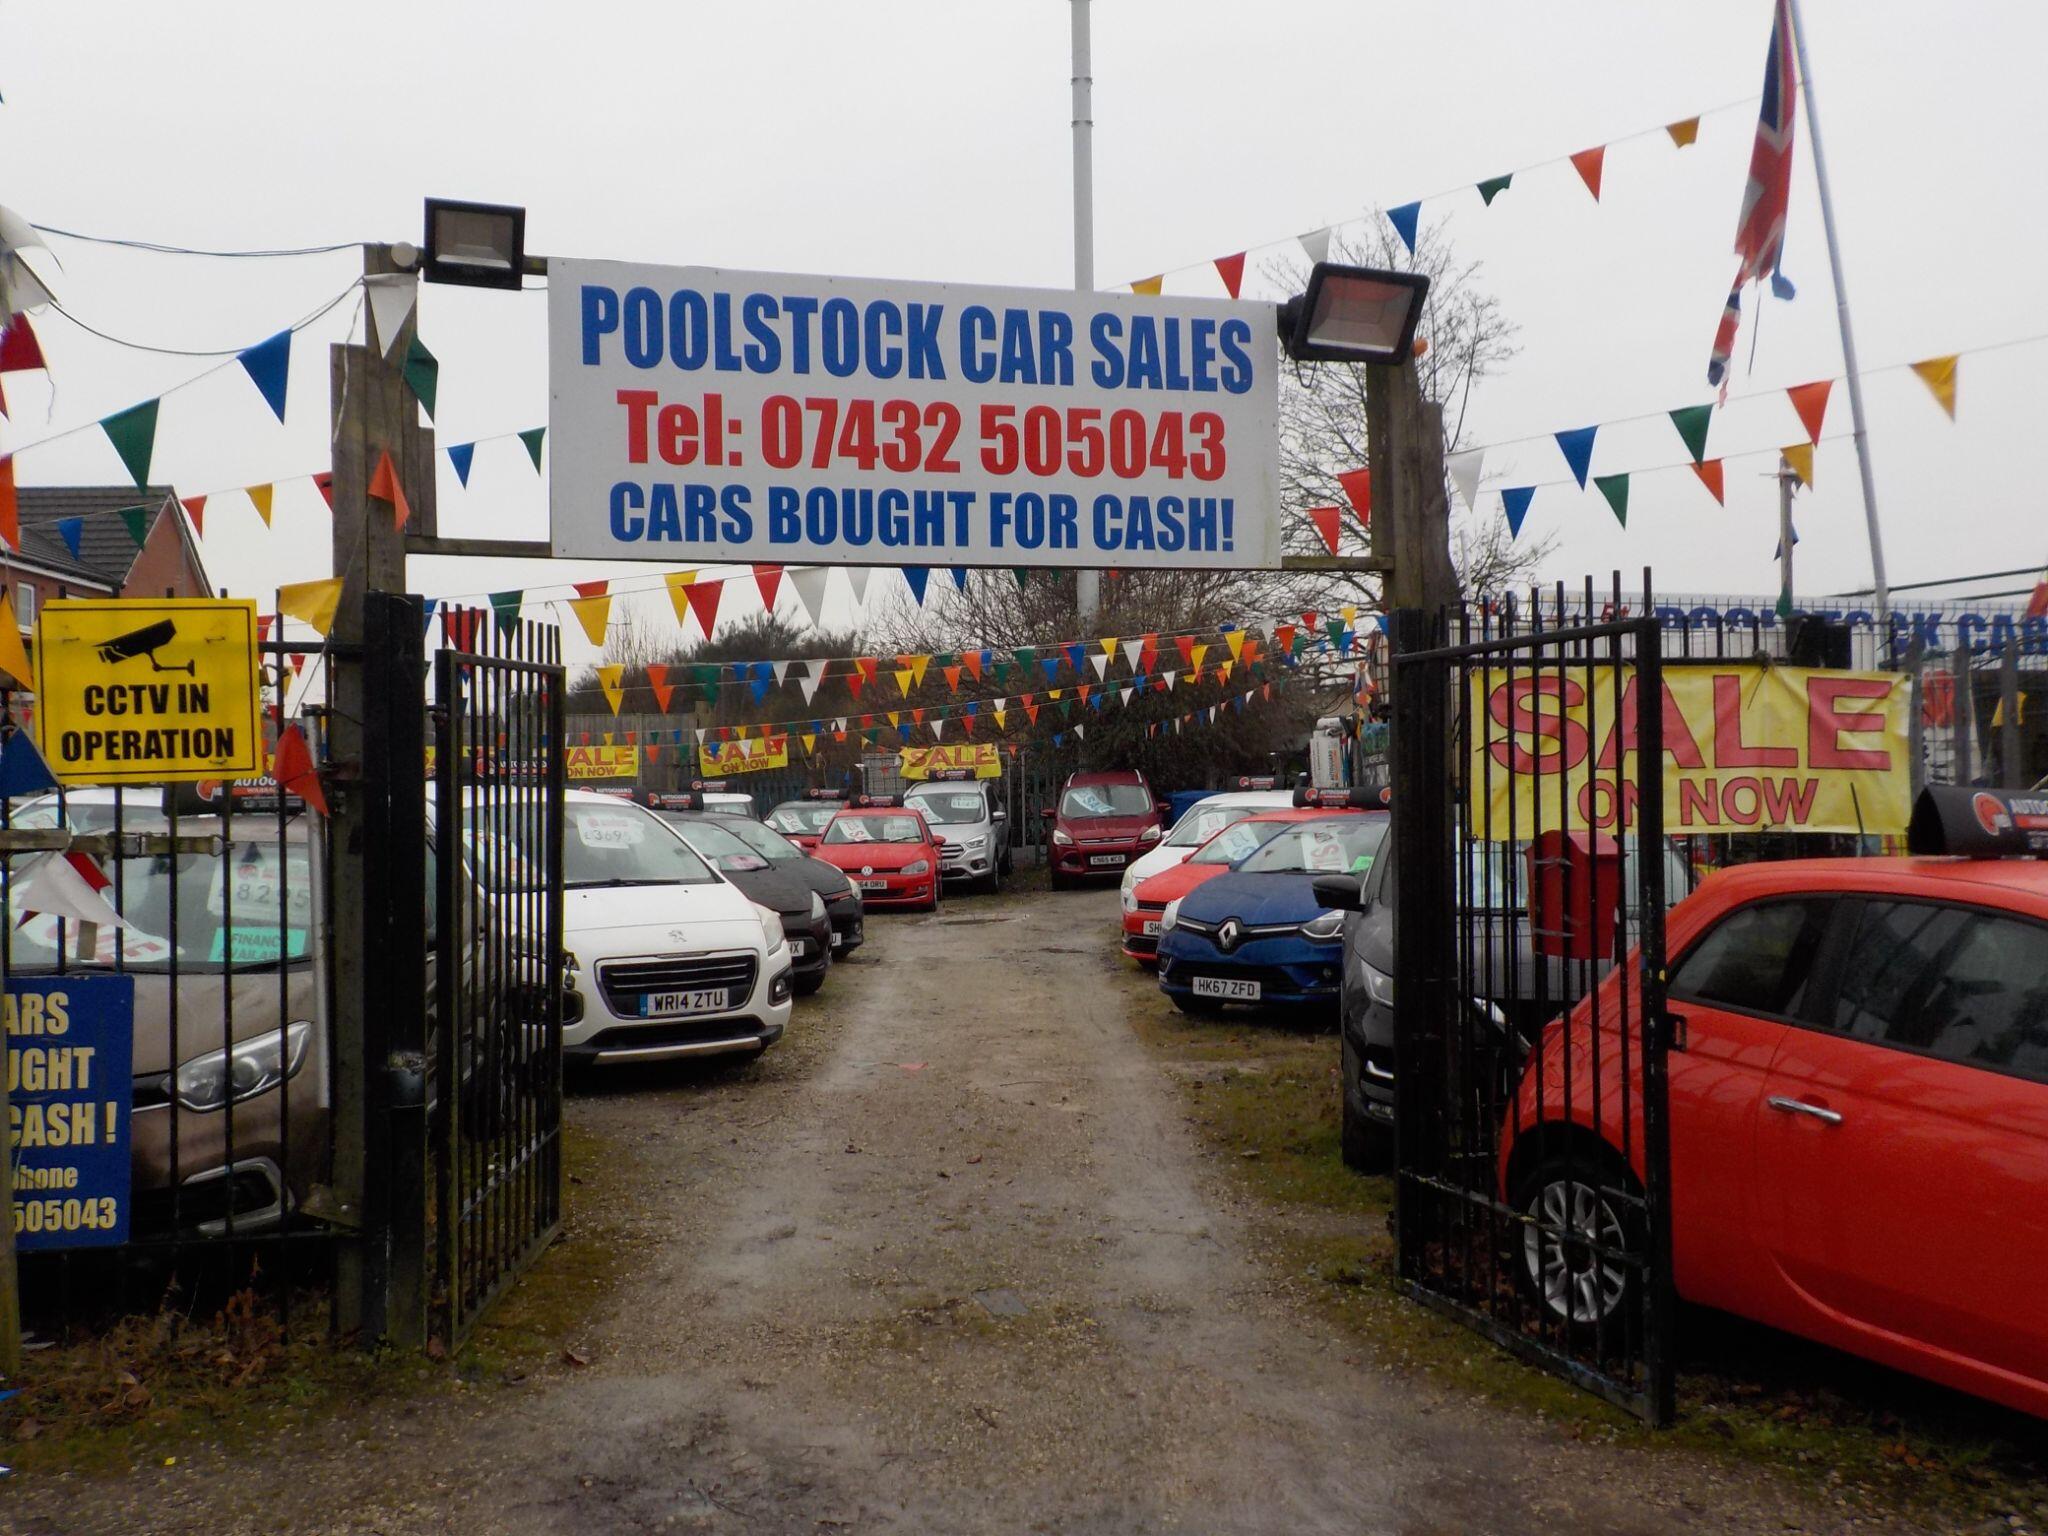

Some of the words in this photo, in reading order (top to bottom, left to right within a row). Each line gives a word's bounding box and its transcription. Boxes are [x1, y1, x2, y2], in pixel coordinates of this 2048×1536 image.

[579, 284, 945, 380] POOLSTOCK
[959, 303, 1075, 387] CAR
[1090, 312, 1253, 394] SALES
[617, 390, 743, 467] Tel:
[761, 395, 961, 473] 07432
[979, 404, 1227, 481] 505043
[609, 482, 753, 544] CARS
[768, 486, 976, 548] BOUGHT
[989, 492, 1079, 550] FOR
[1093, 494, 1235, 553] CASH!
[84, 684, 169, 716] CCTV
[178, 683, 209, 713] IN
[1488, 674, 1893, 776] SALE
[61, 727, 234, 762] OPERATION
[565, 747, 635, 768] ALE
[908, 747, 997, 768] SALE
[587, 766, 617, 777] NOW
[1680, 776, 1820, 826] NOW
[219, 883, 310, 907] 825
[1149, 922, 1161, 933] SH
[231, 933, 281, 948] FINANC
[1197, 979, 1227, 994] HK67
[1231, 981, 1255, 997] ZFD
[654, 992, 688, 1012] WR14
[693, 991, 723, 1009] ZTU
